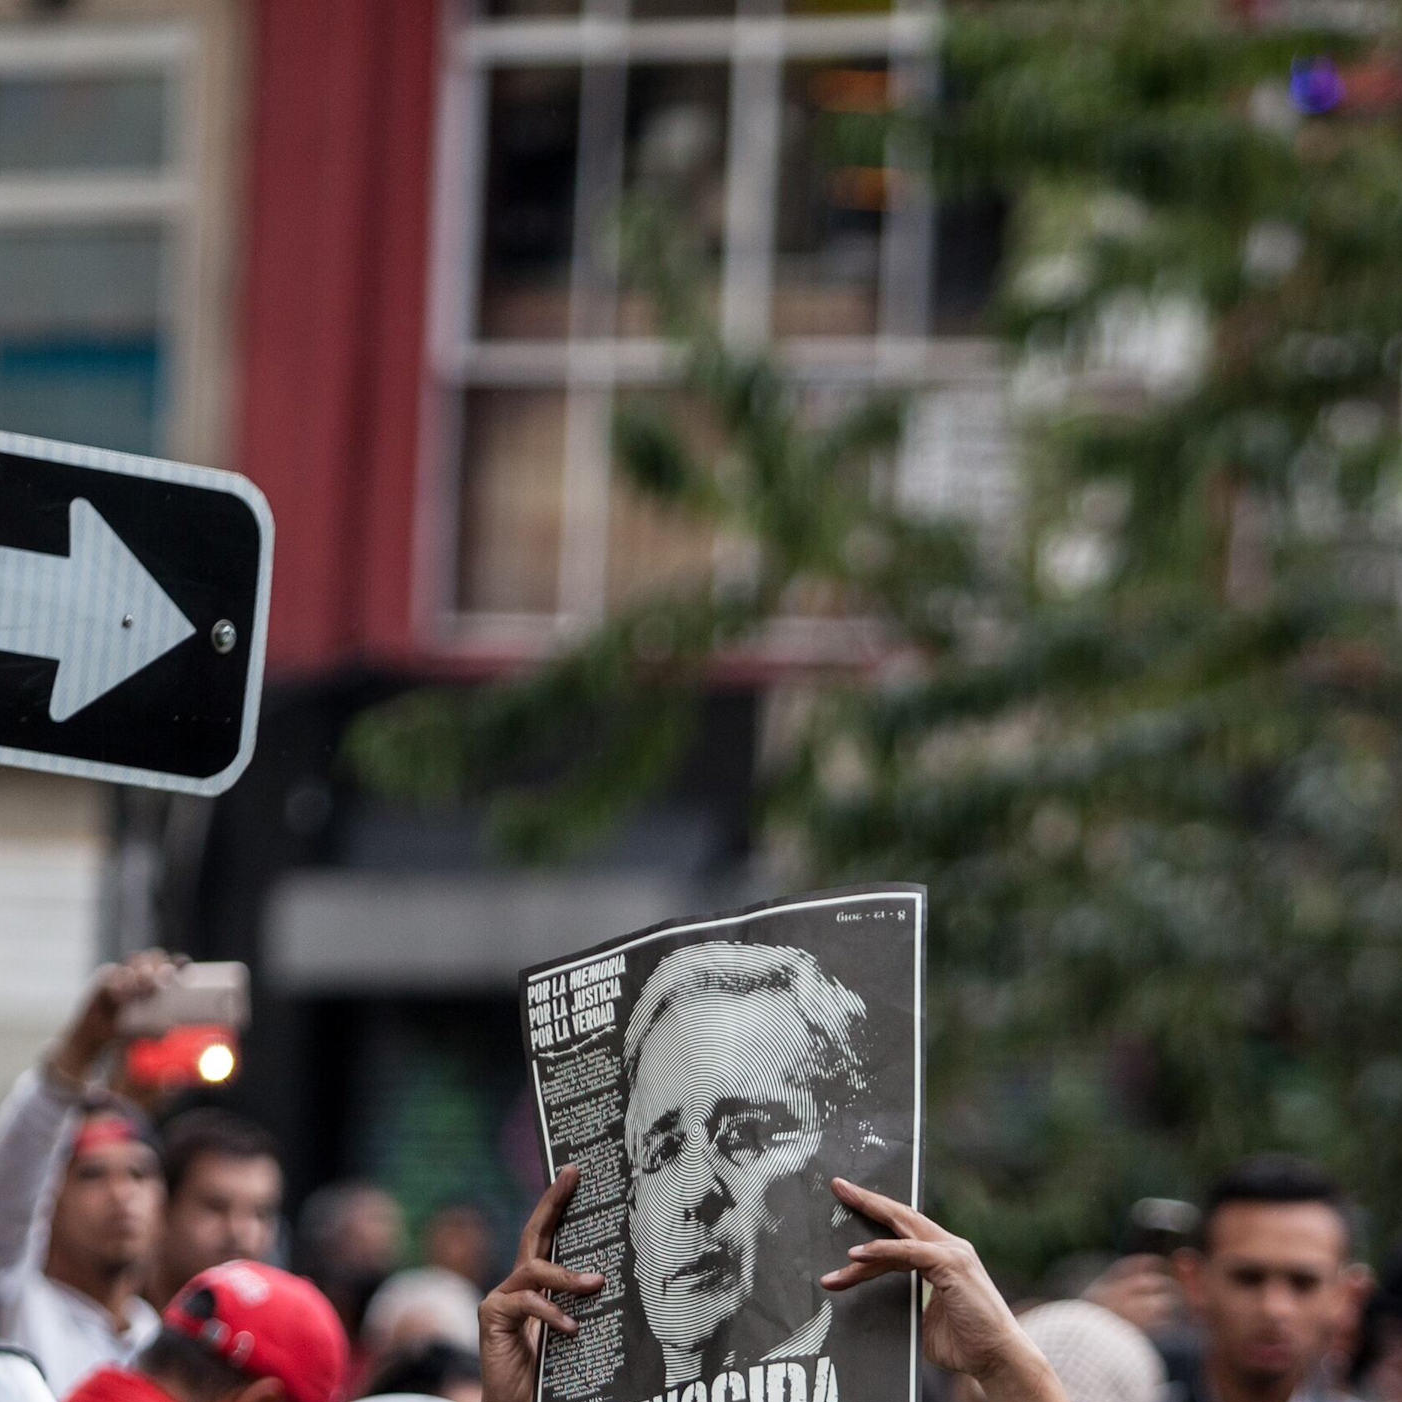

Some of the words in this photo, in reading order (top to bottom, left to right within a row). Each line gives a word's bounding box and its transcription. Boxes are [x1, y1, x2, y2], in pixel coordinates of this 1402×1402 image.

[528, 980, 550, 1006] POR
[552, 974, 566, 994] LA
[569, 953, 626, 992] MEMORIA
[529, 1002, 552, 1029] POR
[553, 996, 568, 1020] LA
[571, 977, 622, 1013] JUSTICIA
[530, 1025, 554, 1053] POR
[555, 1018, 570, 1043] LA
[572, 1001, 616, 1035] VERDAD
